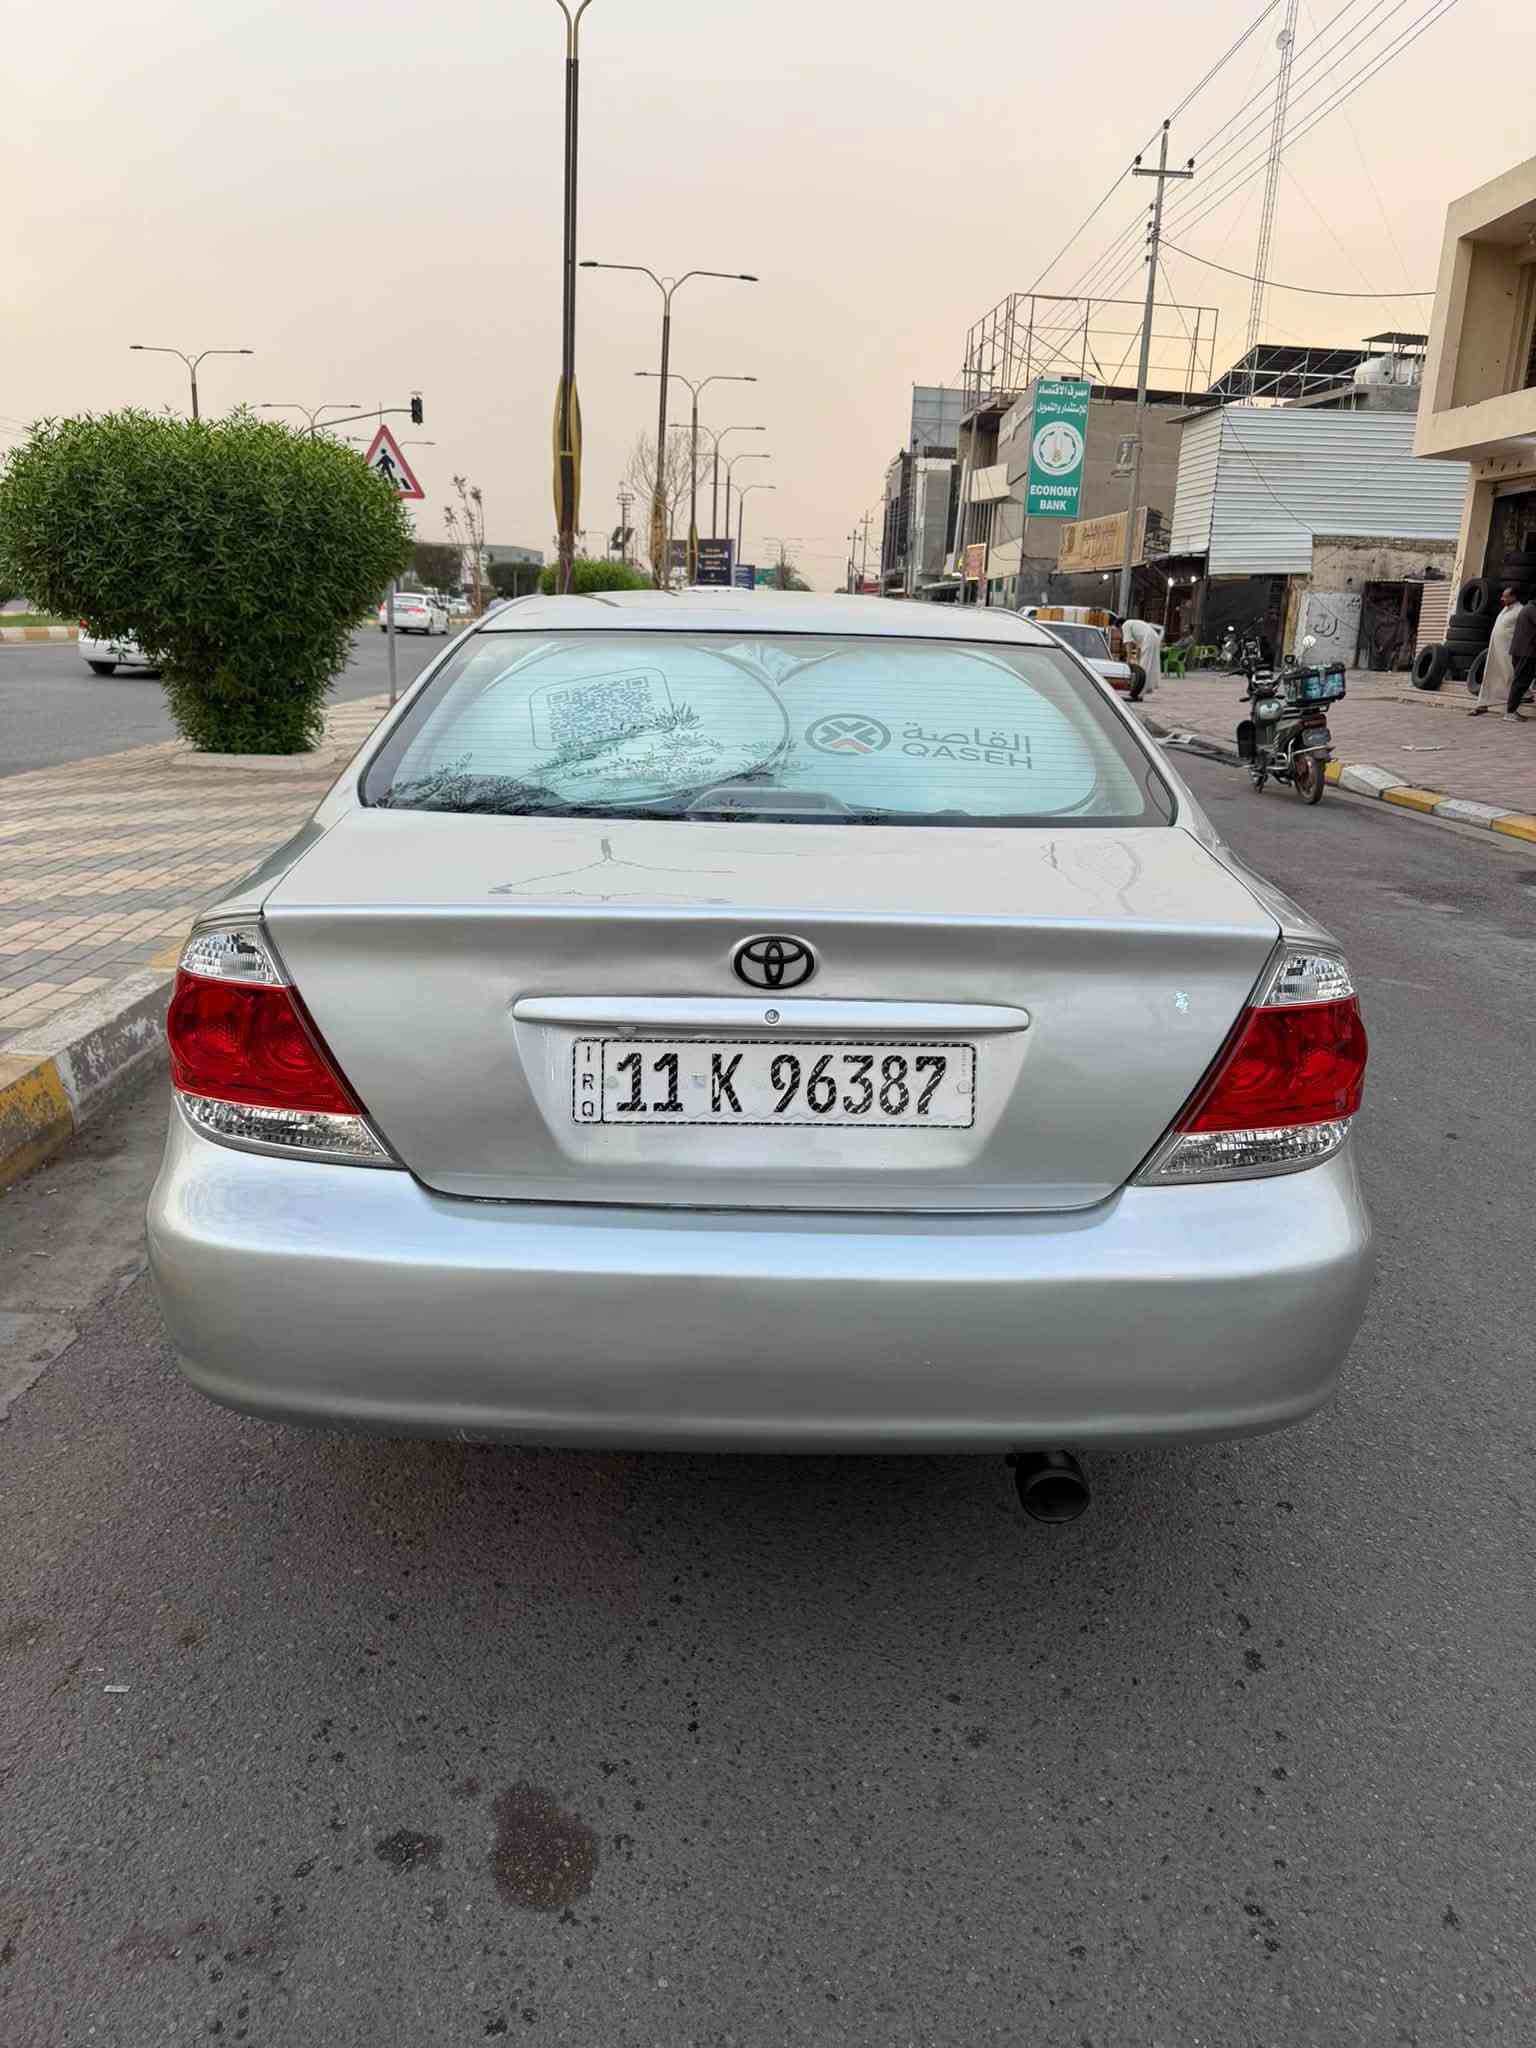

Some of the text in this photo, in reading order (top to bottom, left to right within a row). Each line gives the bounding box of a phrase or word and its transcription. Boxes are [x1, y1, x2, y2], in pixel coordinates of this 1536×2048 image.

[1030, 484, 1079, 497] ECONOMY
[1040, 499, 1067, 511] BANK
[902, 721, 1032, 755] القاصة
[901, 742, 1033, 770] QASEH
[616, 1052, 684, 1112] 11
[711, 1053, 744, 1112] K
[770, 1053, 947, 1116] 96387
